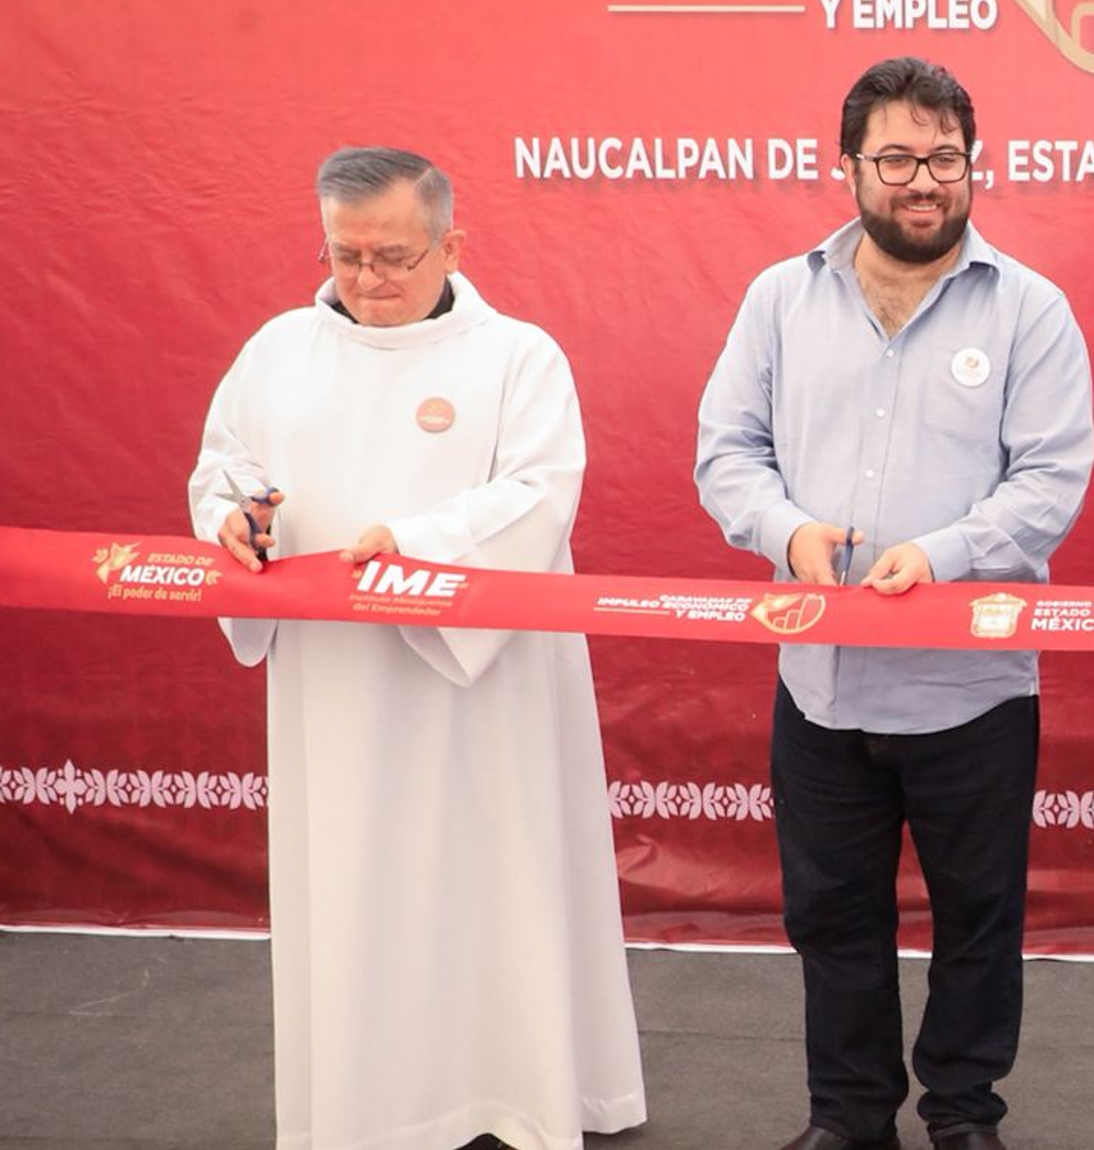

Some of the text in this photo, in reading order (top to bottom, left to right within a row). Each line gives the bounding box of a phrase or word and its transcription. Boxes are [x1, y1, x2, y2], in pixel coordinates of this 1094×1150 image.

[819, 0, 999, 30] Y EMPLEO
[513, 137, 754, 181] NAUCALPAN
[766, 138, 818, 181] DE
[147, 553, 195, 564] ESTADO
[356, 560, 467, 598] IME
[123, 586, 153, 600] poder
[155, 587, 168, 600] de
[675, 609, 746, 622] Y EMPLEO
[1033, 608, 1091, 617] ESTADO
